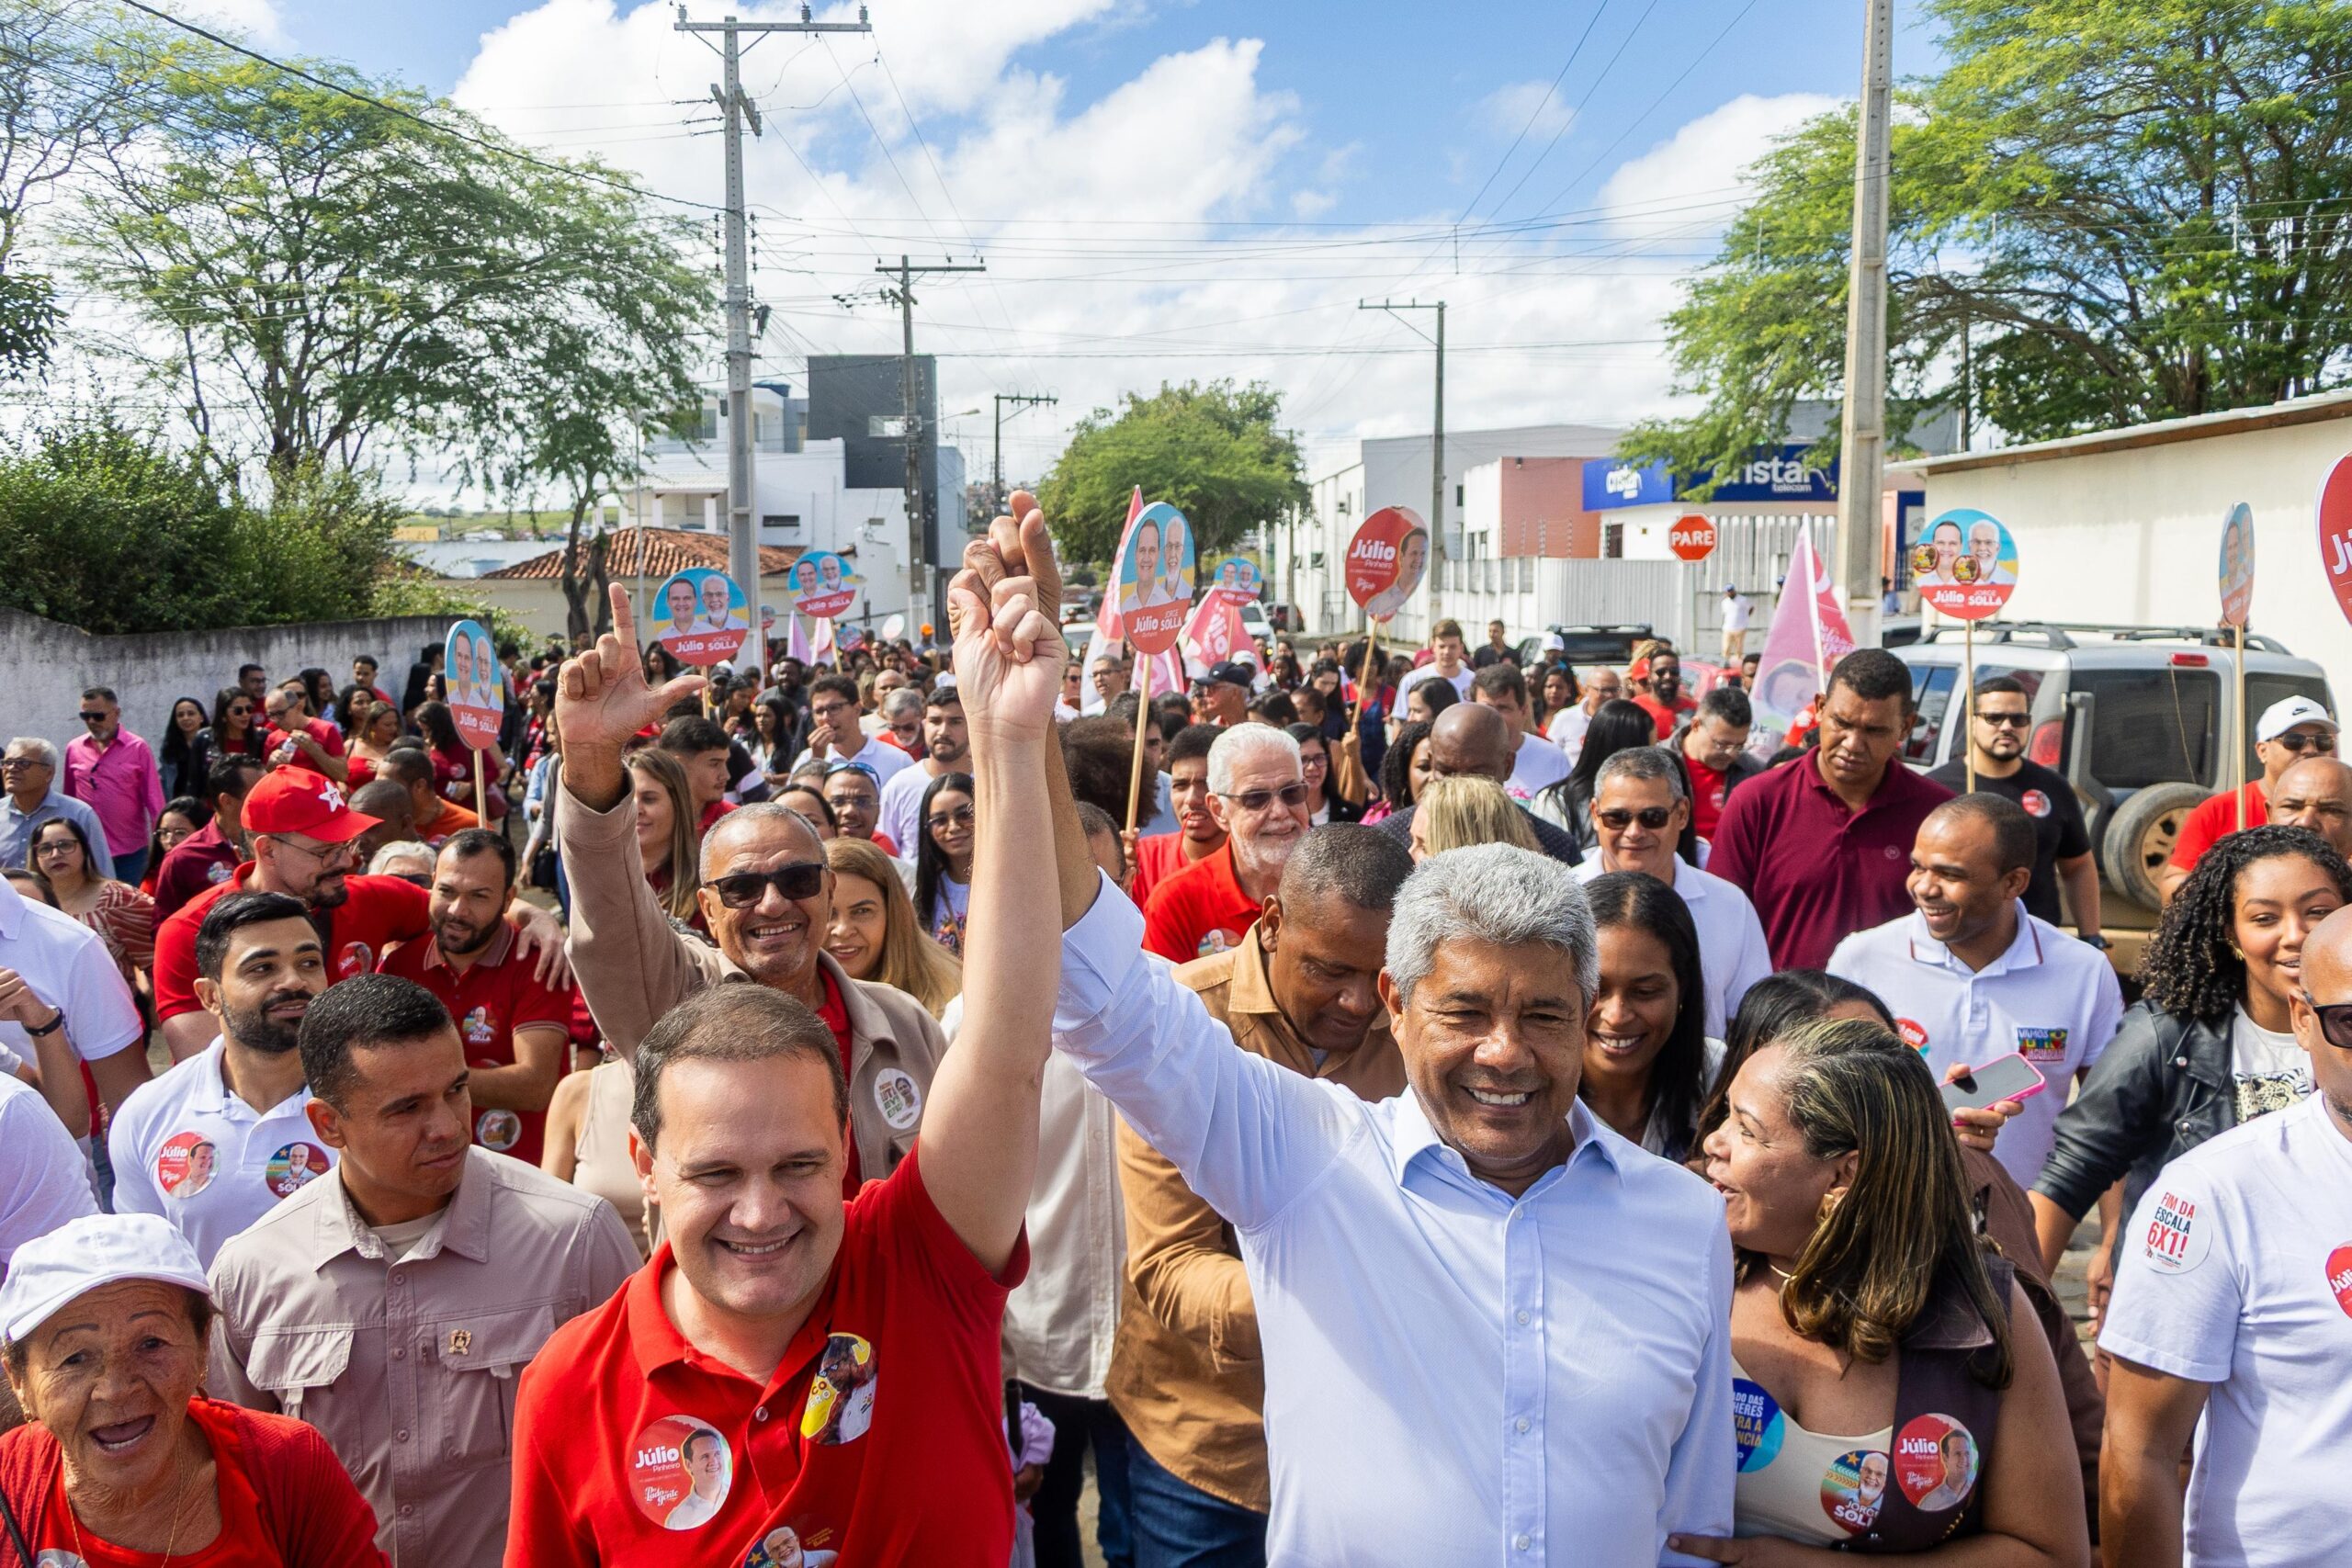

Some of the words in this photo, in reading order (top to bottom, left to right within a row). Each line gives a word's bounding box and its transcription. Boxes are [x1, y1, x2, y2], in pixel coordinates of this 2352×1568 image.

[1772, 484, 1812, 493] telecom
[1671, 531, 1714, 547] PARE
[1350, 539, 1396, 561] Júlio
[1932, 590, 1965, 604] Júlio
[1968, 595, 2003, 606] SOLLA
[1133, 615, 1159, 634] Júlio
[1159, 616, 1182, 631] SOLLA
[675, 640, 705, 653] Júlio
[707, 640, 739, 651] SOLLA
[479, 720, 499, 734] SOLLA
[161, 1145, 188, 1158] Júlio
[2161, 1191, 2178, 1211] FIM
[2178, 1201, 2195, 1219] DA
[2154, 1206, 2191, 1235] ESCALA
[2147, 1221, 2188, 1258] 6X1!
[1748, 1393, 1764, 1405] DAS
[1754, 1418, 1763, 1432] A
[1900, 1438, 1939, 1454] Júlio
[635, 1446, 679, 1469] Júlio
[653, 1462, 680, 1472] Pinheiro
